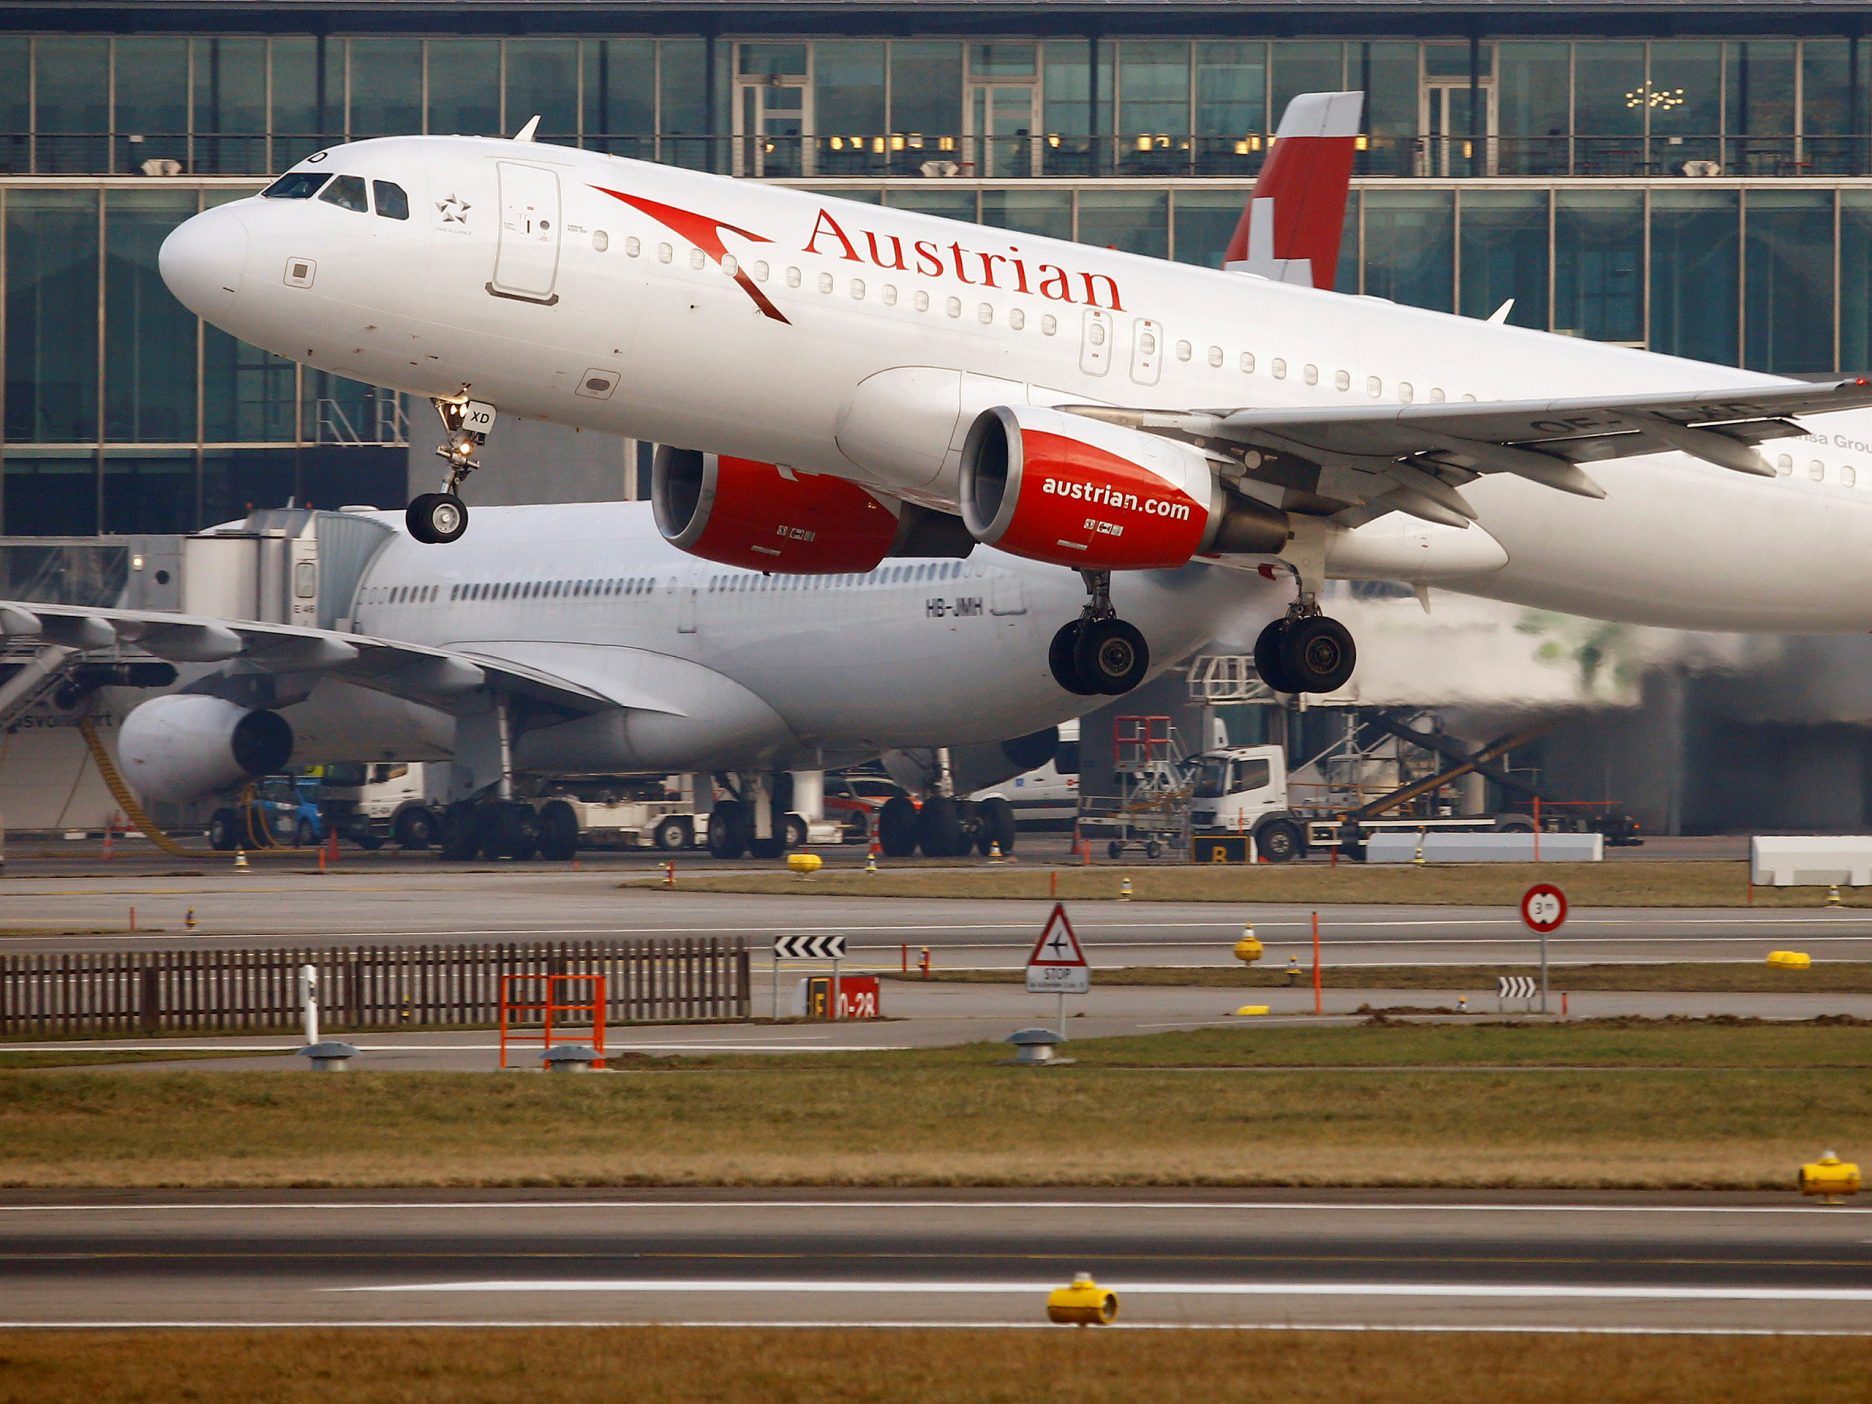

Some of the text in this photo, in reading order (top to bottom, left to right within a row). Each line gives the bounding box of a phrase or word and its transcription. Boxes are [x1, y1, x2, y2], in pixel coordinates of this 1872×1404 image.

[801, 208, 1127, 312] Austrian
[470, 411, 490, 424] XD
[1042, 477, 1190, 521] austrian.com
[1044, 967, 1071, 980] STOP
